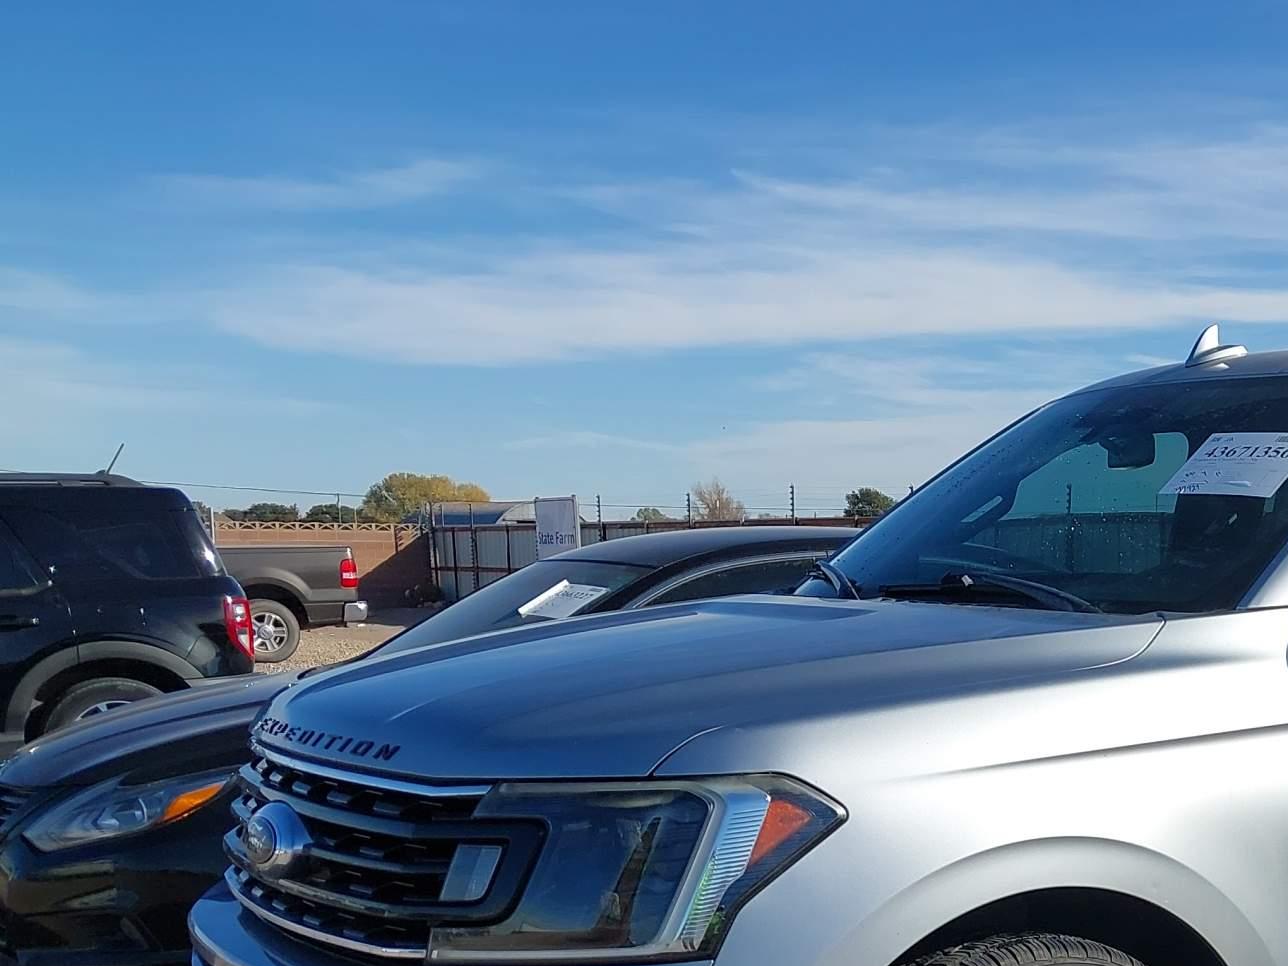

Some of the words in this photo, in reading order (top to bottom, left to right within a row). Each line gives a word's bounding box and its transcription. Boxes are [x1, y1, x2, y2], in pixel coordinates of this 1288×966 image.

[538, 531, 554, 545] State
[555, 531, 575, 545] Farm
[260, 717, 401, 761] EXPEDITION
